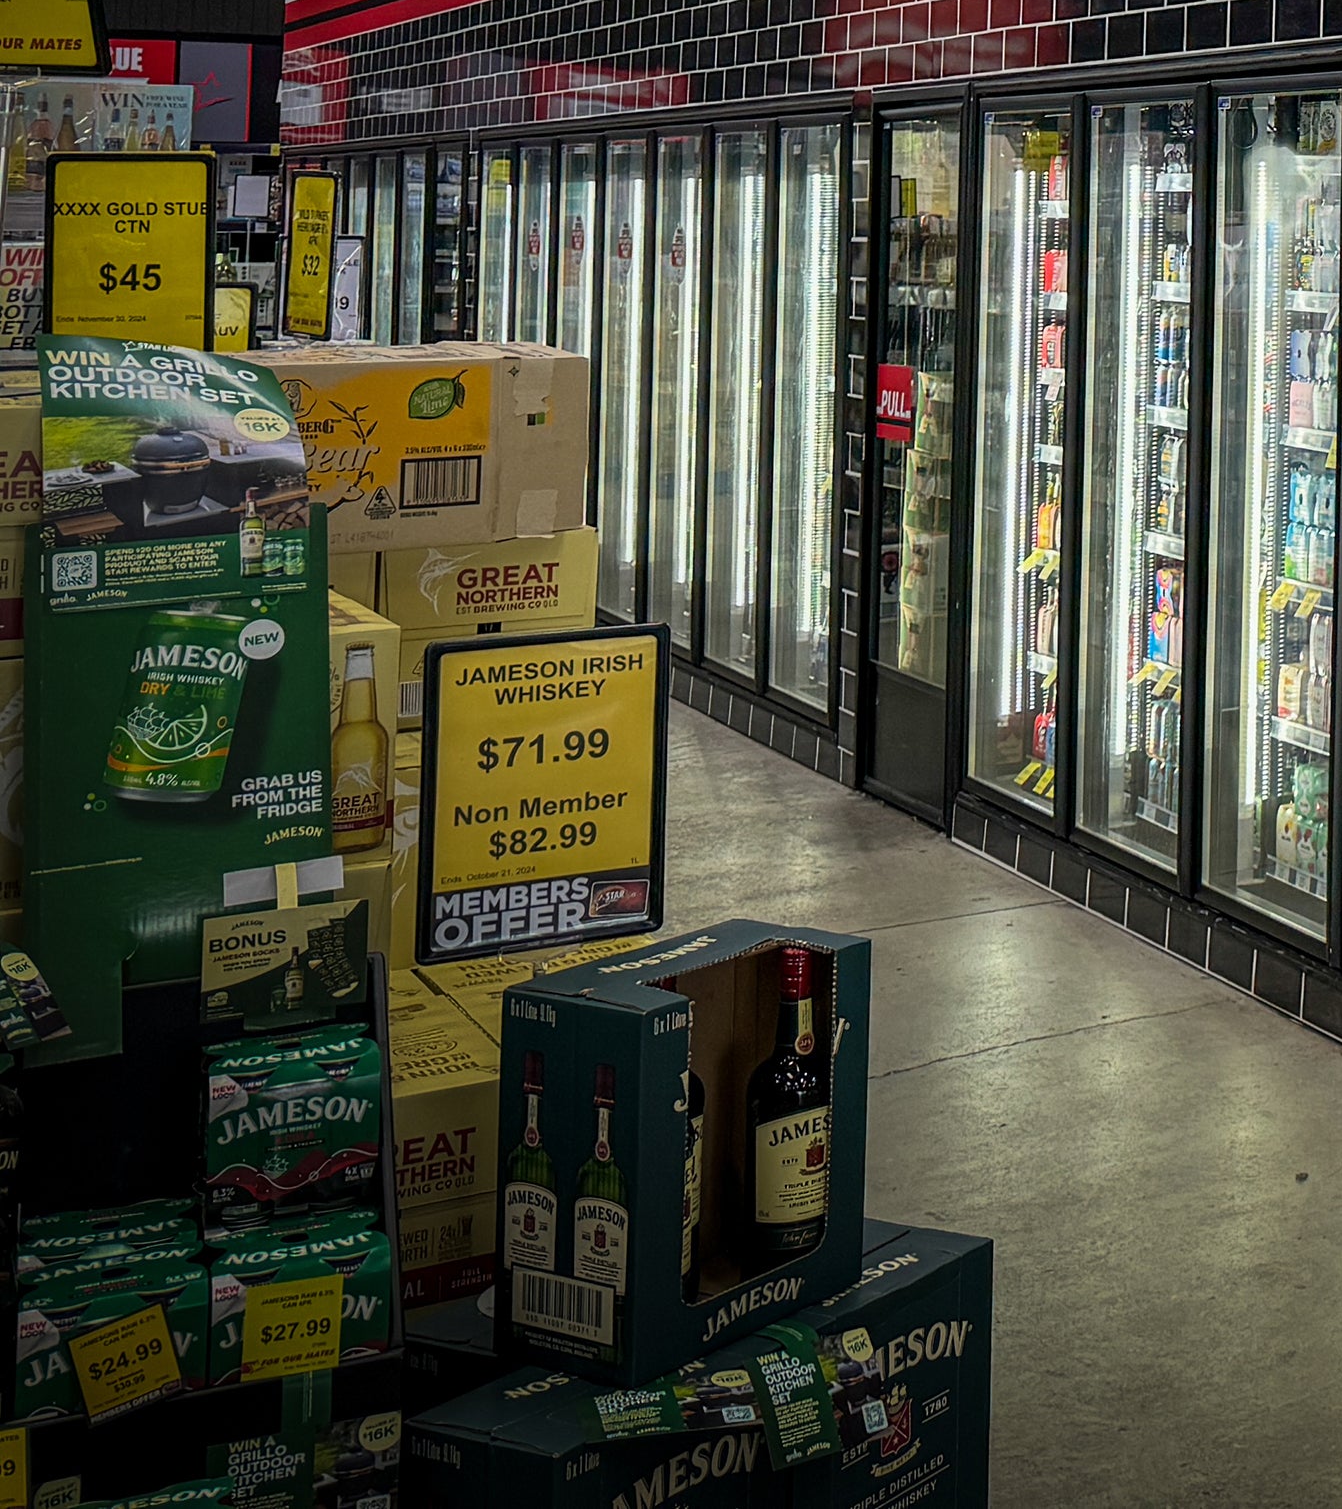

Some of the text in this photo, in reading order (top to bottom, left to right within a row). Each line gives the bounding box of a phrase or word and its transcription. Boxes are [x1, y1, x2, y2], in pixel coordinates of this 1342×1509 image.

[30, 38, 82, 50] MATES
[101, 93, 146, 108] WIN
[53, 202, 208, 216] XXXX GOLD STUB
[114, 220, 150, 234] CTN
[302, 255, 320, 277] $32
[99, 262, 161, 295] $45
[45, 350, 258, 382] WIN A GRILLO
[48, 366, 206, 387] OUTDOOR
[51, 381, 255, 405] KITCHEN SET
[881, 390, 905, 417] PULL
[457, 562, 559, 588] GREAT
[456, 584, 558, 606] NORTHERN
[474, 601, 525, 614] BREWING
[244, 631, 279, 647] NEW
[130, 645, 248, 681] JAMESON
[455, 653, 643, 686] JAMESON IRISH
[140, 682, 170, 696] DRY
[147, 672, 224, 686] IRISH WHISKEY
[494, 679, 606, 706] WHISKEY
[477, 728, 610, 773] $71.99
[145, 772, 178, 787] 4.8%
[241, 769, 323, 792] GRAB US
[231, 784, 323, 808] FROM THE
[257, 800, 323, 819] FRIDGE
[454, 790, 628, 827] Non Member
[264, 825, 323, 846] JAMESON
[489, 820, 598, 859] $82.99
[441, 875, 462, 885] Ends
[466, 868, 499, 882] October
[516, 865, 536, 876] 2024
[435, 877, 589, 919] MEMBERS
[435, 902, 586, 948] OFFER
[209, 930, 286, 953] BONUS
[216, 1095, 368, 1146] JAMESON
[508, 1190, 555, 1216] JAMESON
[576, 1206, 626, 1230] JAMESON
[702, 1277, 802, 1343] JAMESON
[261, 1318, 330, 1346] $27.99
[89, 1339, 162, 1381] $24.99
[756, 1351, 789, 1366] WIN A
[762, 1357, 801, 1375] GRILLO
[765, 1363, 817, 1386] OUTDOOR
[768, 1375, 815, 1397] KITCHEN
[772, 1393, 792, 1407] SET
[924, 1395, 948, 1416] 1780
[890, 1453, 945, 1492] DISTILLED
